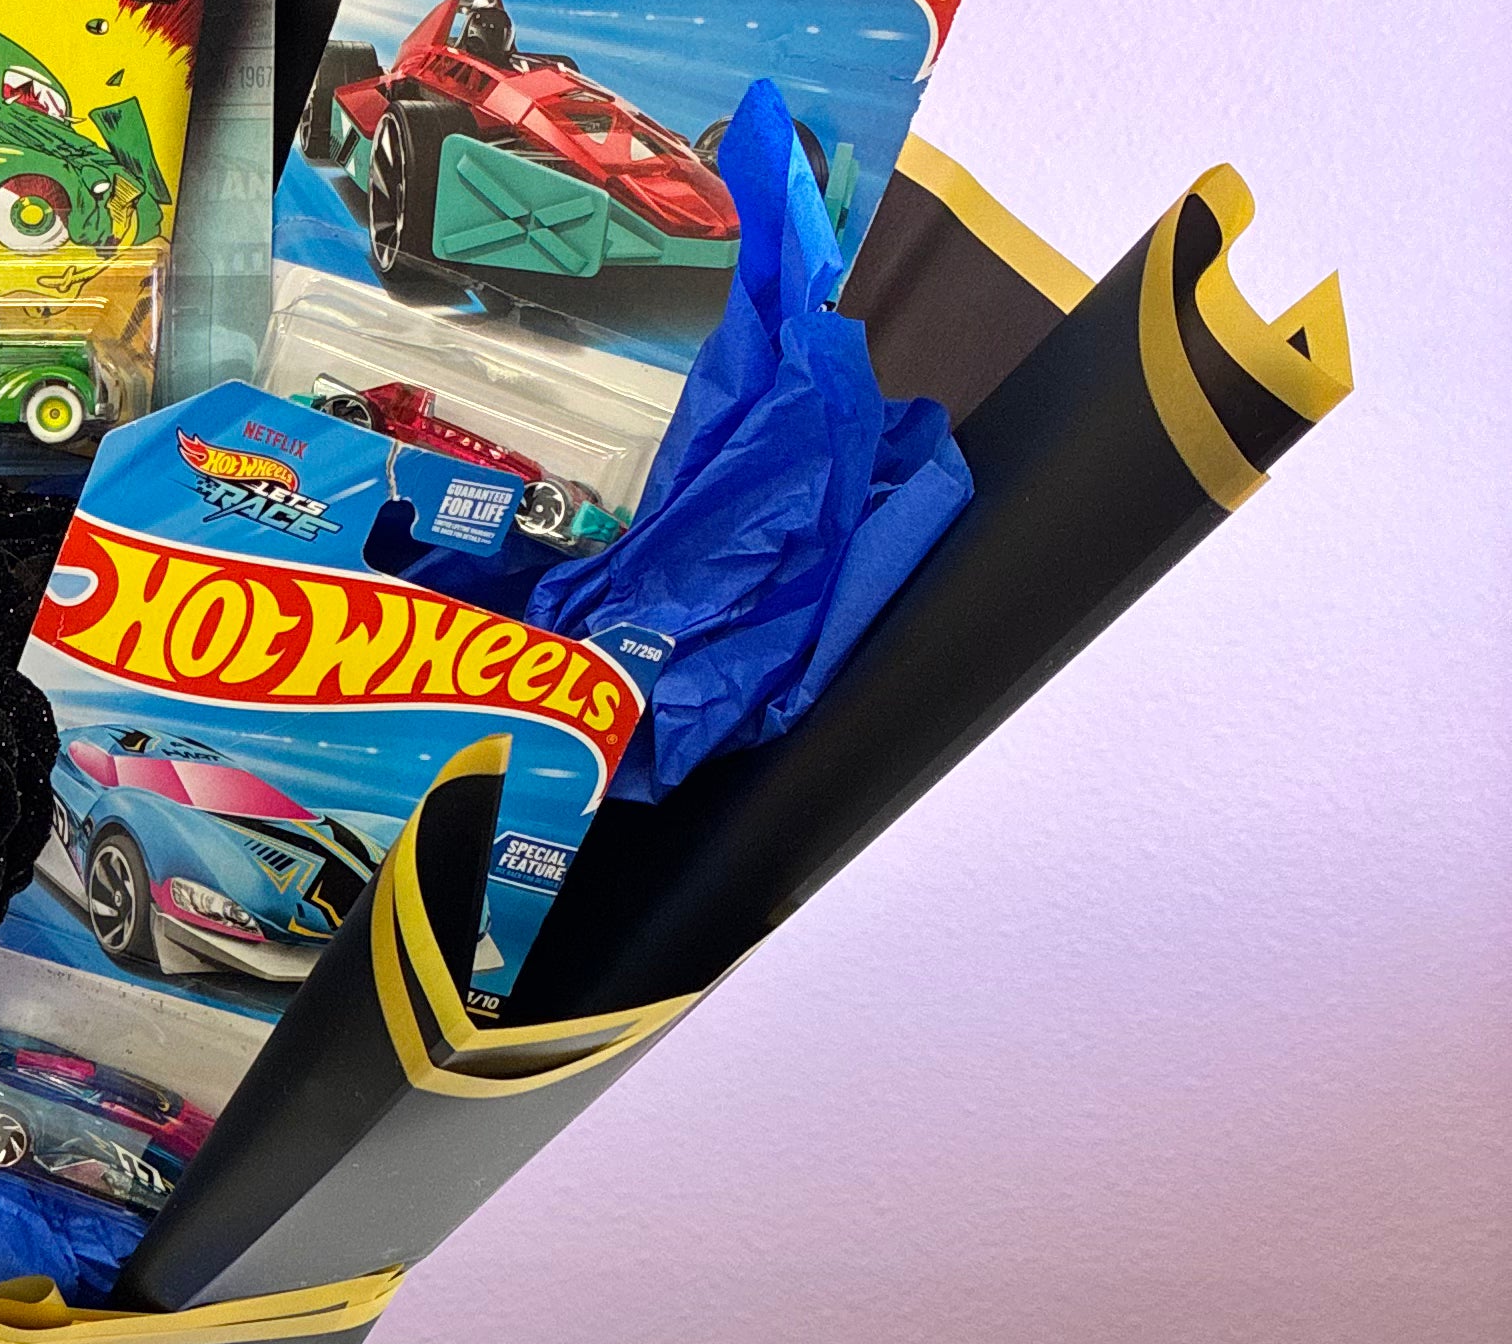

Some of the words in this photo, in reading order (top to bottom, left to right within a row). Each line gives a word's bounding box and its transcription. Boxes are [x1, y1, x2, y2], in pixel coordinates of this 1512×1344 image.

[239, 65, 272, 89] 1967
[243, 421, 309, 459] NETFLIX
[251, 481, 329, 516] LET'S
[446, 483, 513, 505] GUARANTEED
[203, 483, 343, 541] RACE
[438, 496, 474, 518] FOR
[472, 501, 505, 524] LIFE
[620, 638, 662, 663] 37/250
[498, 853, 567, 881] FEATURE
[507, 840, 567, 867] SPECIAL
